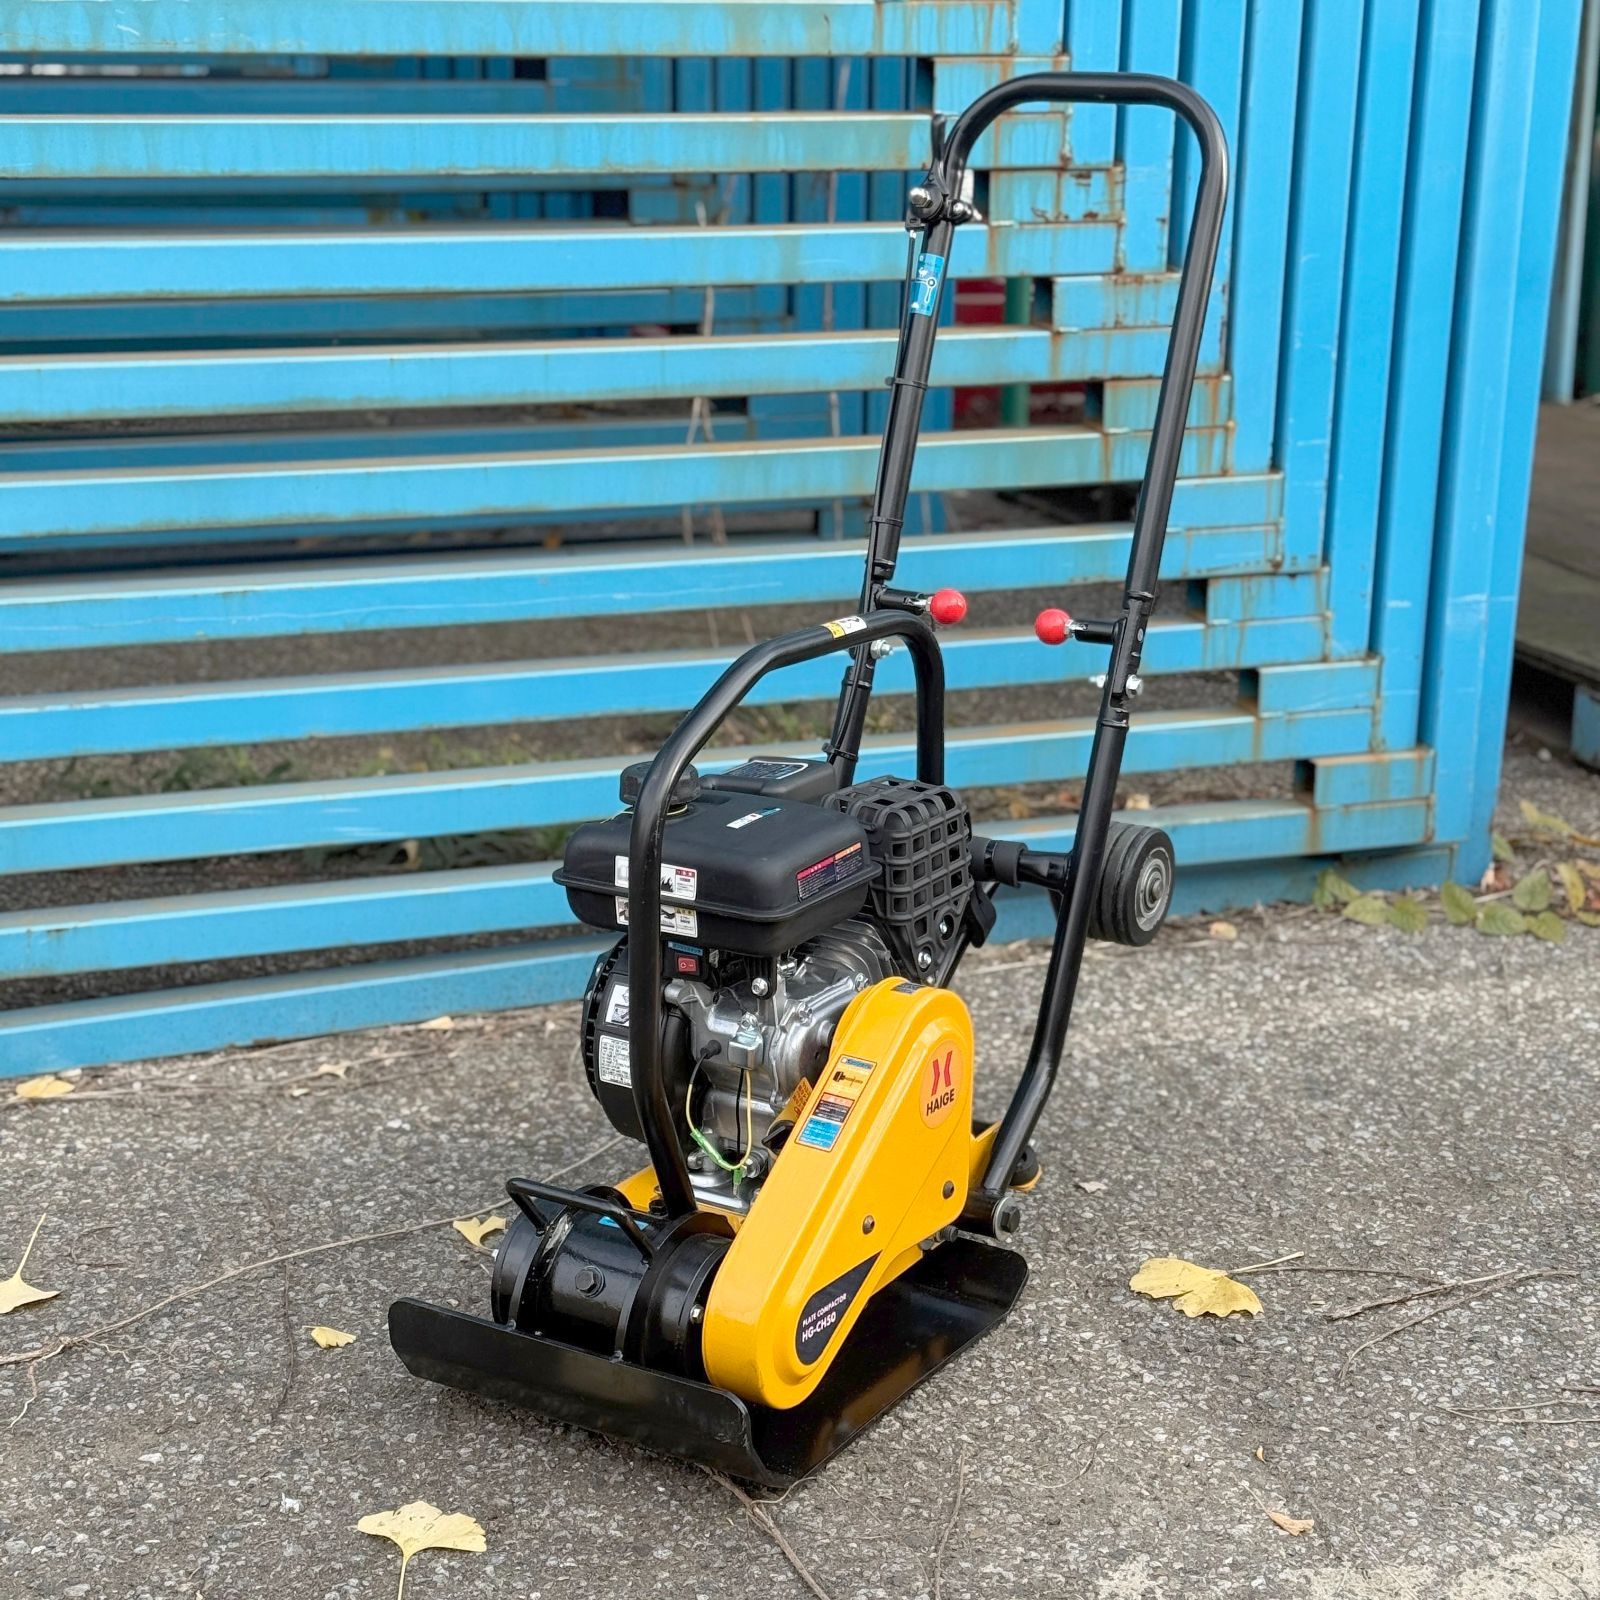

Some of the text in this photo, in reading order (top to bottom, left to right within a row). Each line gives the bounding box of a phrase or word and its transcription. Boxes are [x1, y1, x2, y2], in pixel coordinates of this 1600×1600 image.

[926, 1088, 955, 1117] HAIGE
[802, 1292, 847, 1328] PLATE COMPACTOR
[801, 1311, 836, 1343] HG-CH50
